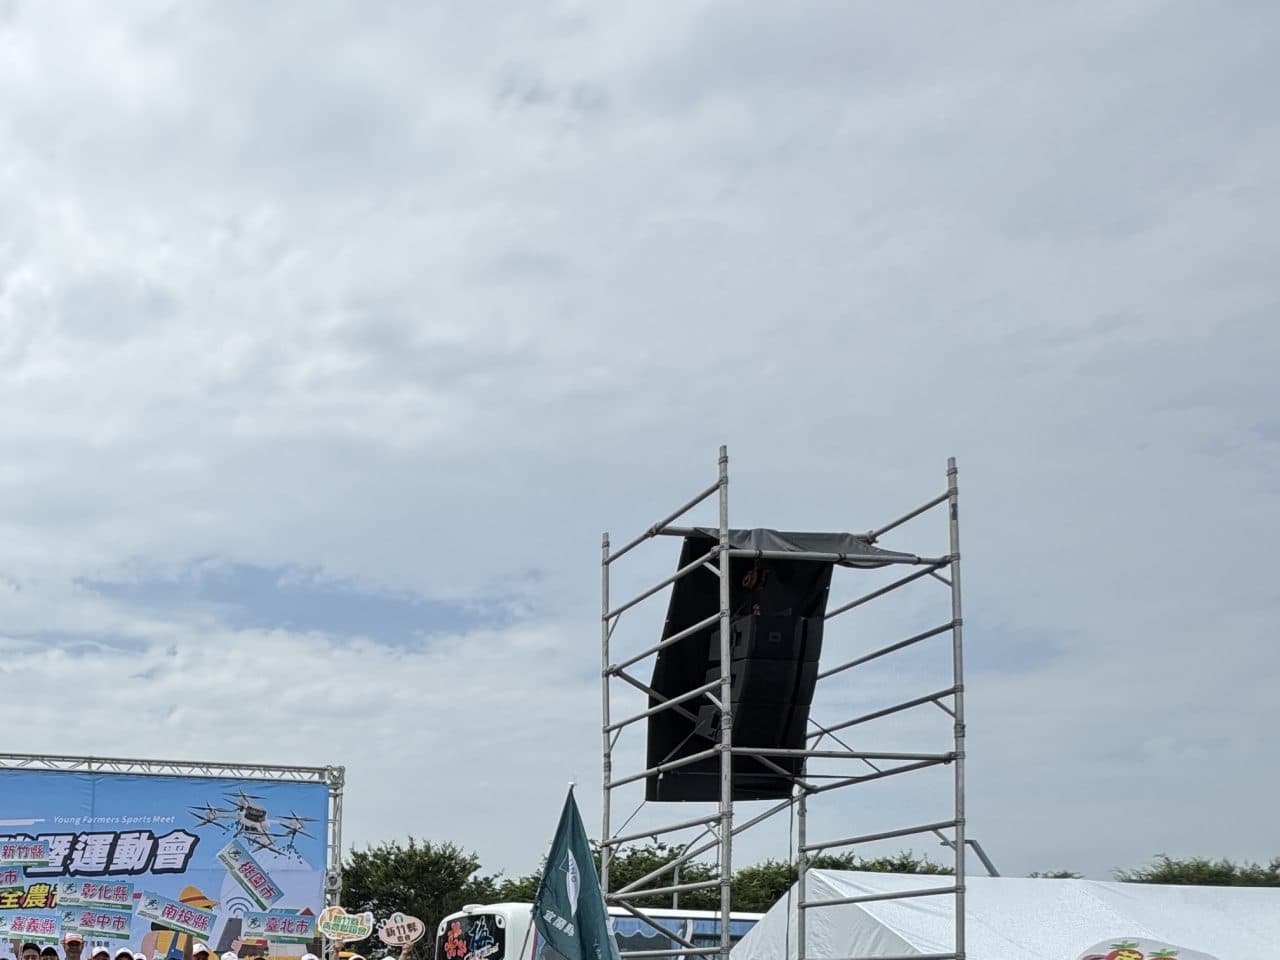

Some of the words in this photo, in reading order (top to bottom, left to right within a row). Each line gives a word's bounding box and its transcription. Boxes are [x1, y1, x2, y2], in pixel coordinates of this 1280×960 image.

[53, 816, 81, 825] Young
[83, 816, 119, 824] Farmers
[120, 816, 150, 825] Sports
[2, 844, 45, 858] 新竹縣
[239, 862, 276, 900] 桃園市
[81, 883, 129, 902] 彰化縣
[11, 917, 56, 935] 嘉義縣
[79, 912, 126, 930] 臺中市
[161, 903, 209, 931] 南投縣
[265, 917, 308, 935] 臺北市
